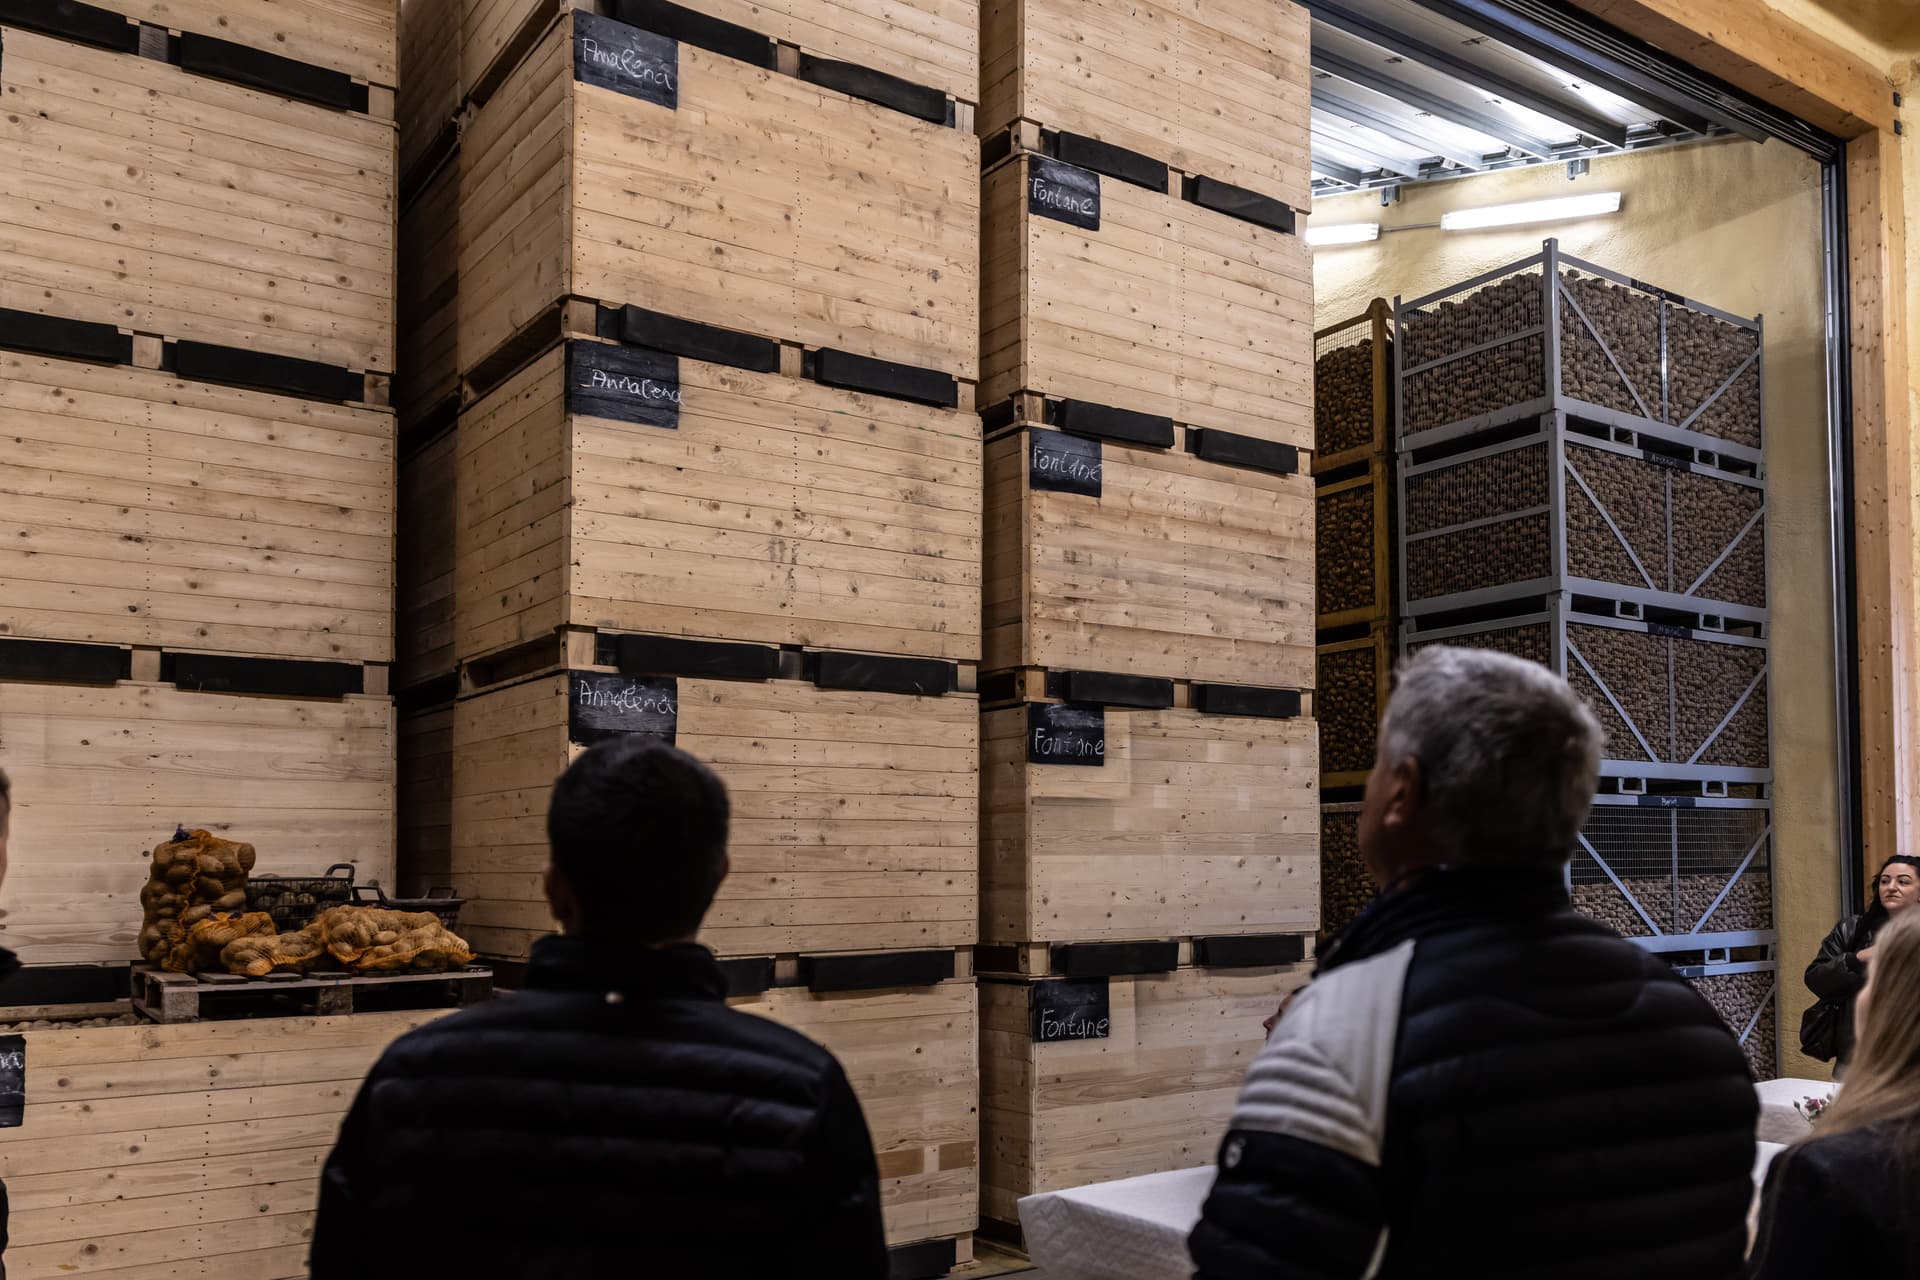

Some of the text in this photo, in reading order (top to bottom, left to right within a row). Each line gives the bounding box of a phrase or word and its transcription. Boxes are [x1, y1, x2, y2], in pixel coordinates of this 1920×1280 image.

[1033, 178, 1096, 215] Fontane
[1034, 445, 1104, 481] Fontane
[1035, 727, 1104, 757] Fontane
[1041, 1008, 1109, 1040] Fontane
